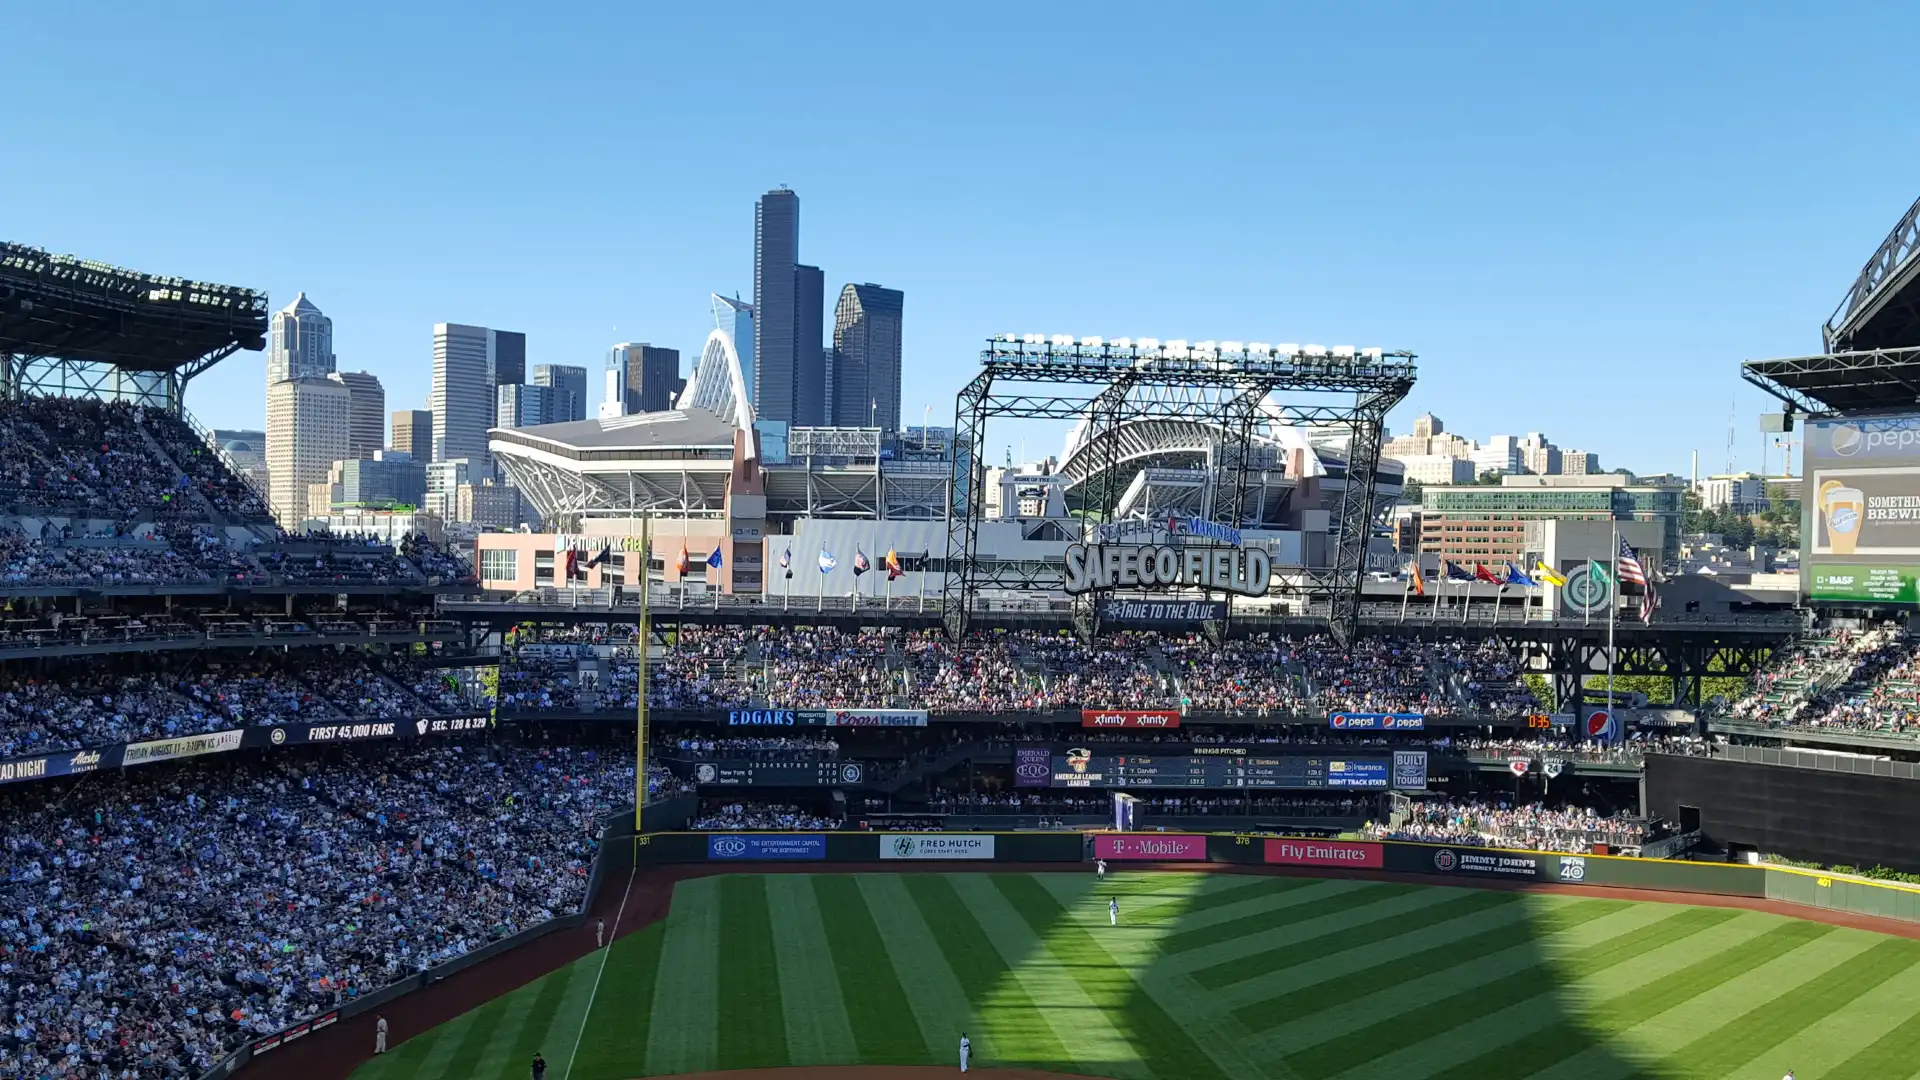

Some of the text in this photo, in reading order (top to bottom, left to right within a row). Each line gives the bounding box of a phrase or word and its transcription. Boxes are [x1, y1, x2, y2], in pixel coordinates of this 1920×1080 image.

[1868, 509, 1920, 520] BREWI
[1099, 516, 1242, 545] SEATTLE MARINERS
[1064, 543, 1272, 598] SAFECO FIELD
[1829, 576, 1854, 585] BASF
[1119, 601, 1216, 620] TRUE TO THE BLUE
[432, 717, 487, 732] SEC. 128 & 329
[729, 710, 795, 726] EDGAR'S
[835, 711, 879, 726] Coors
[1094, 713, 1168, 726] xfinity xfinity
[1348, 717, 1423, 728] pepsi pepsi
[308, 722, 396, 741] FIRST 45,000 FANS
[148, 743, 173, 758] AUGUST
[70, 750, 101, 766] Alaska
[1396, 755, 1424, 765] BUILT
[16, 759, 47, 779] NIGHT
[72, 764, 98, 773] AIRLINES
[1513, 763, 1525, 772] 42
[1547, 764, 1559, 773] 24
[1082, 773, 1102, 781] LEAGUE
[1347, 778, 1368, 786] TRACK
[1368, 778, 1387, 786] STATS
[1396, 776, 1424, 785] TOUGH
[920, 840, 982, 848] FRED HUTCH
[1235, 836, 1250, 845] 376
[1281, 844, 1366, 860] Fly Emirates
[1461, 854, 1536, 868] JIMMY JOHN'S
